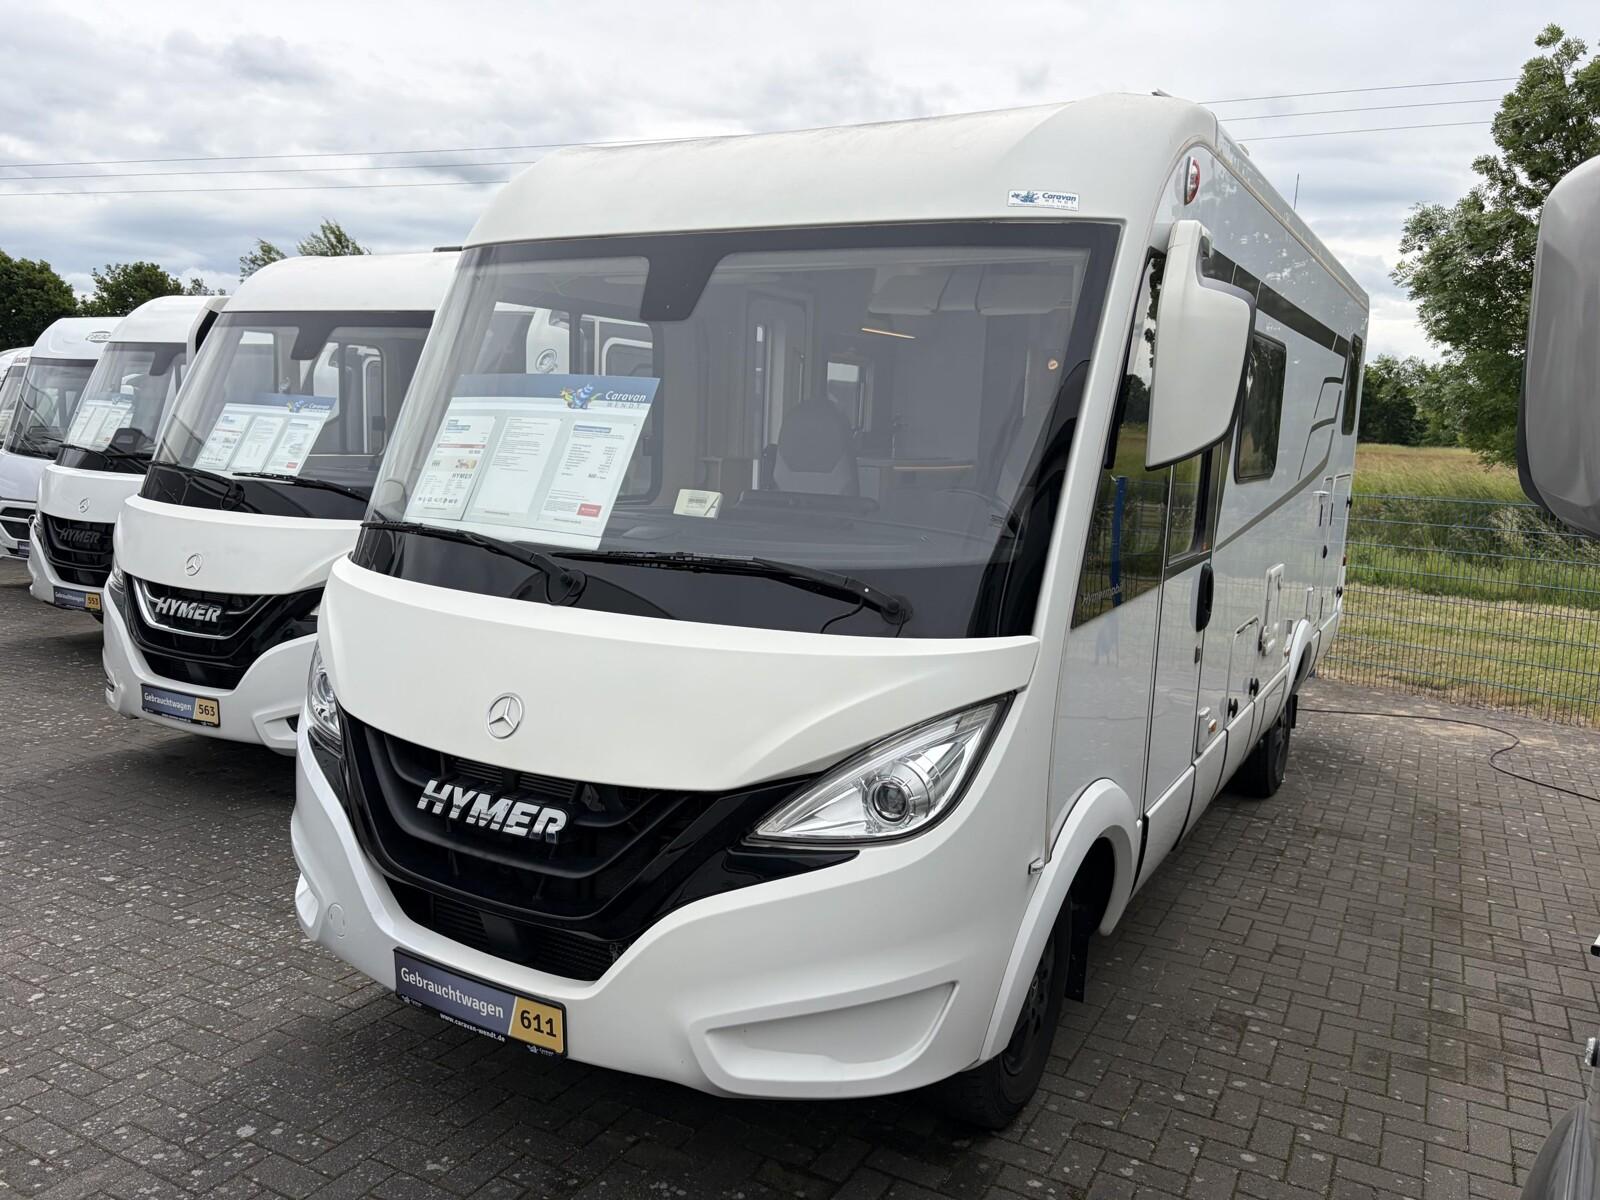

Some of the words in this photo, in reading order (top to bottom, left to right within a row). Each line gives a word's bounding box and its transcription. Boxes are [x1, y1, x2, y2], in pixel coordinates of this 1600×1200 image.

[1042, 192, 1076, 202] Caravan
[605, 390, 646, 402] Caravan
[60, 527, 100, 543] HYMER
[87, 596, 99, 605] 553
[155, 597, 222, 622] HYMER
[144, 692, 192, 711] Gebrauchtwagen
[198, 704, 216, 717] 563
[416, 779, 567, 844] HYMER
[400, 967, 504, 1019] Gebrauchtwagen
[520, 1009, 557, 1037] 611
[439, 1013, 506, 1043] www.caravan-wendt.de
